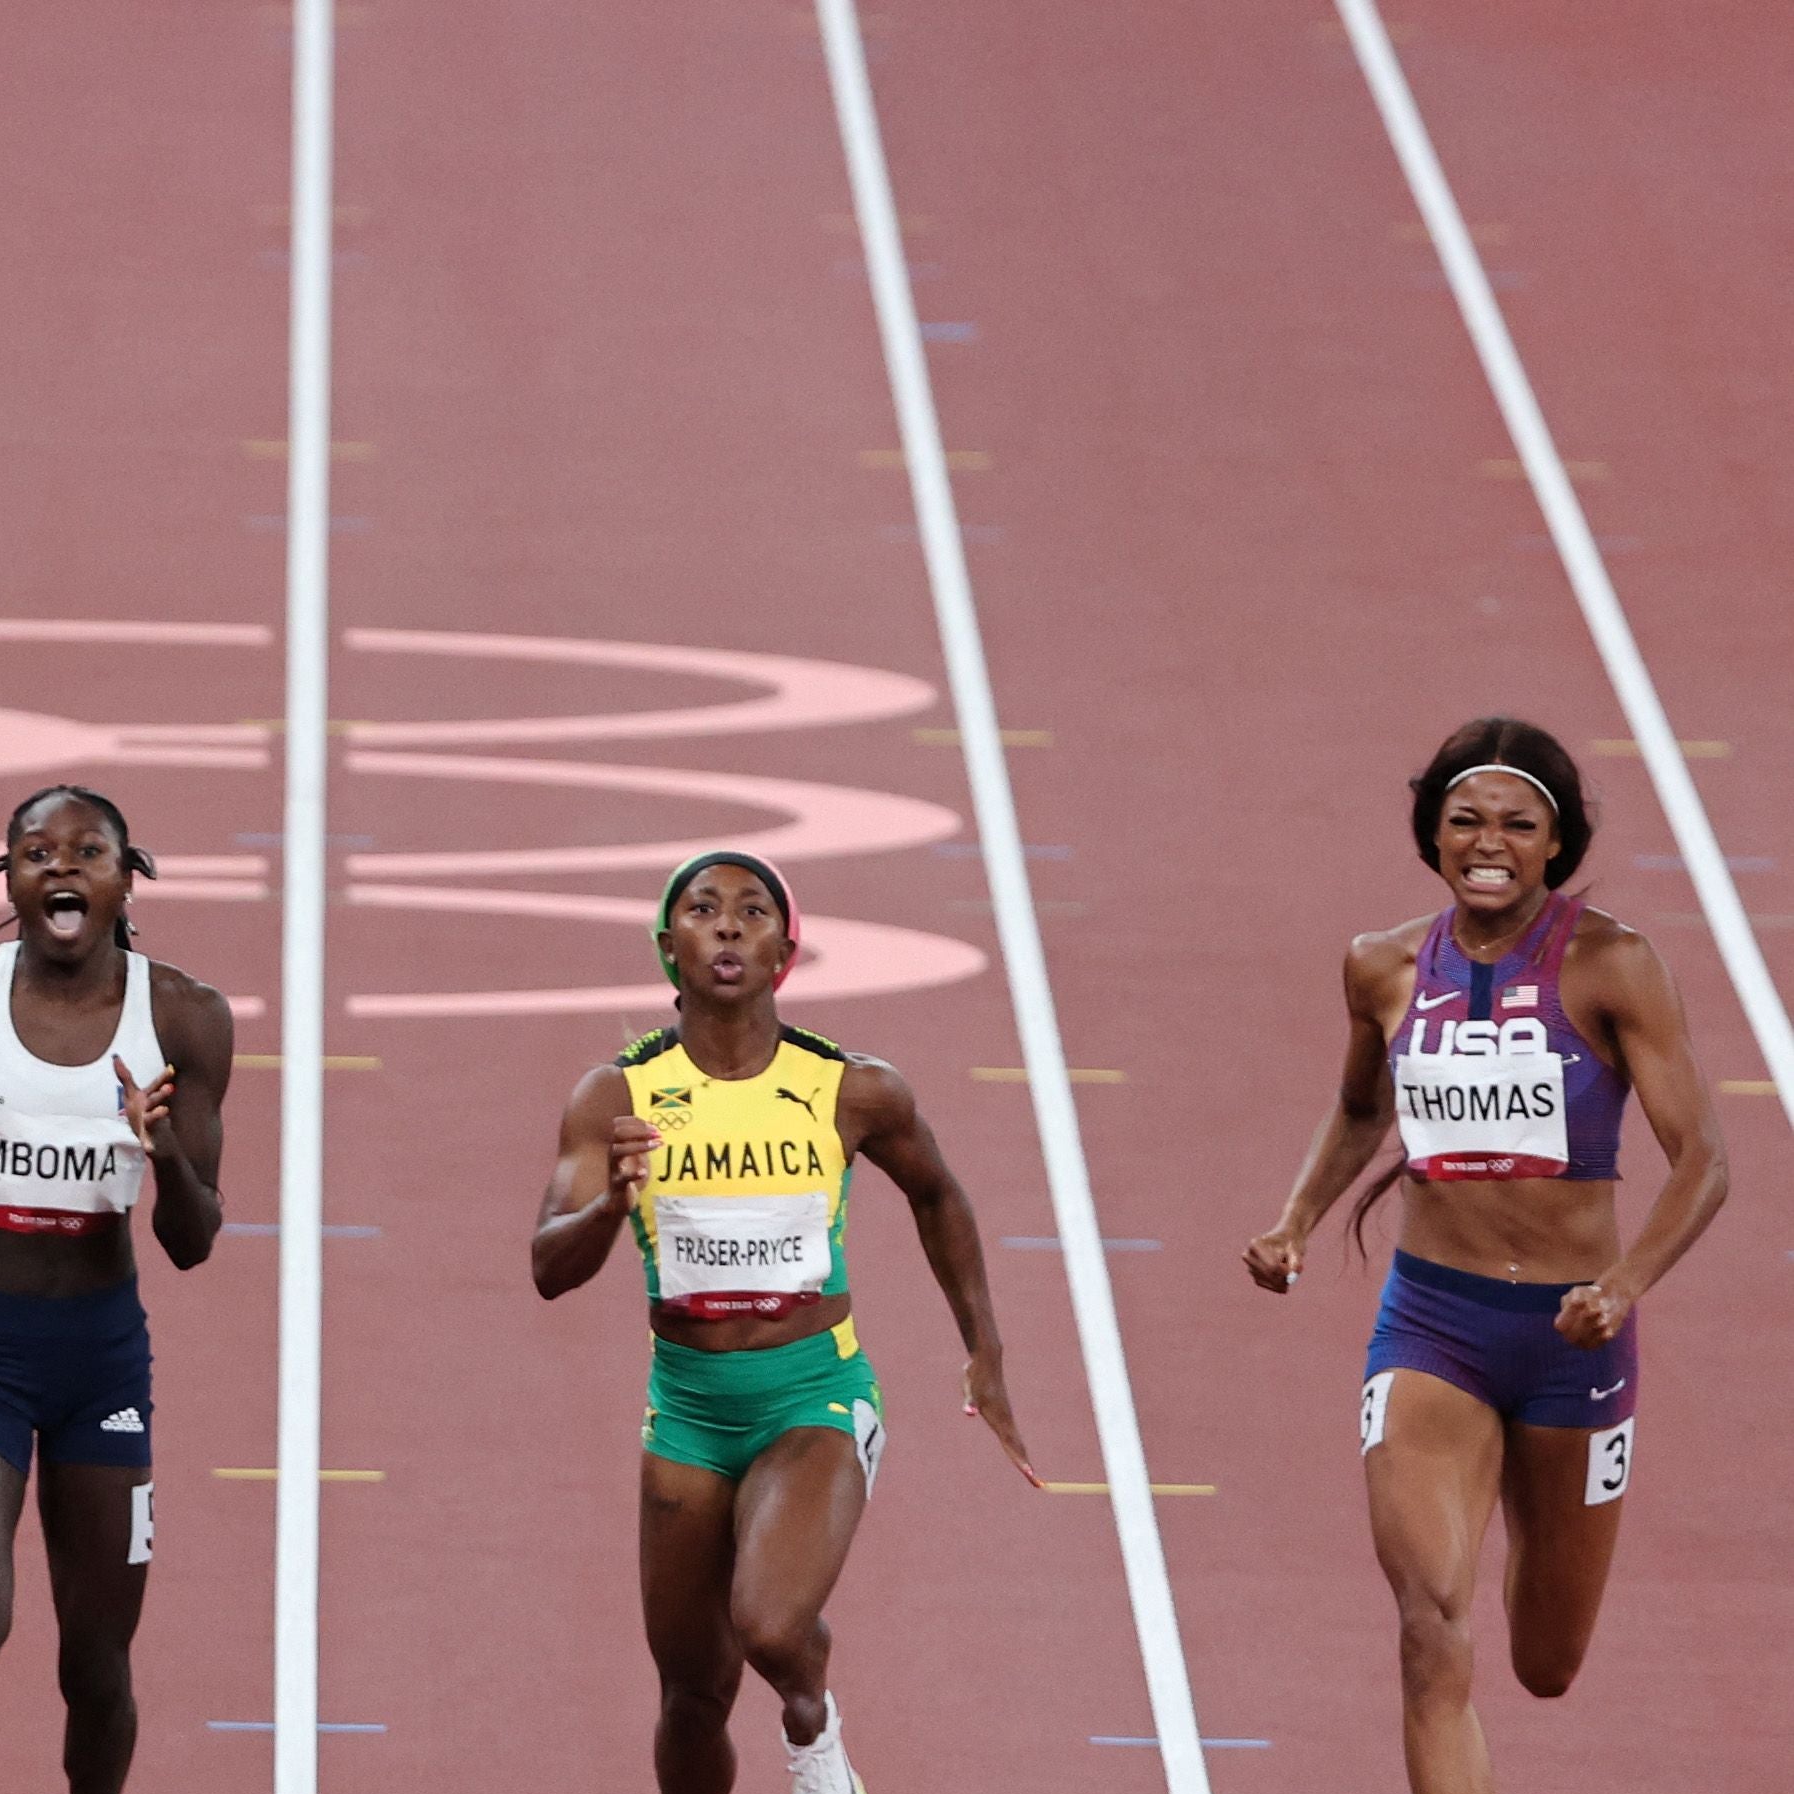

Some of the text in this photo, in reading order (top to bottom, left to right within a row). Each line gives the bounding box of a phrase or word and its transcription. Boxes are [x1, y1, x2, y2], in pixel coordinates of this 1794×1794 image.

[1408, 1016, 1549, 1056] USA
[1403, 1083, 1555, 1122] THOMAS
[657, 1140, 825, 1182] JAMAICA
[674, 1236, 804, 1267] FRASER-PRYCE
[1602, 1432, 1626, 1491] 3
